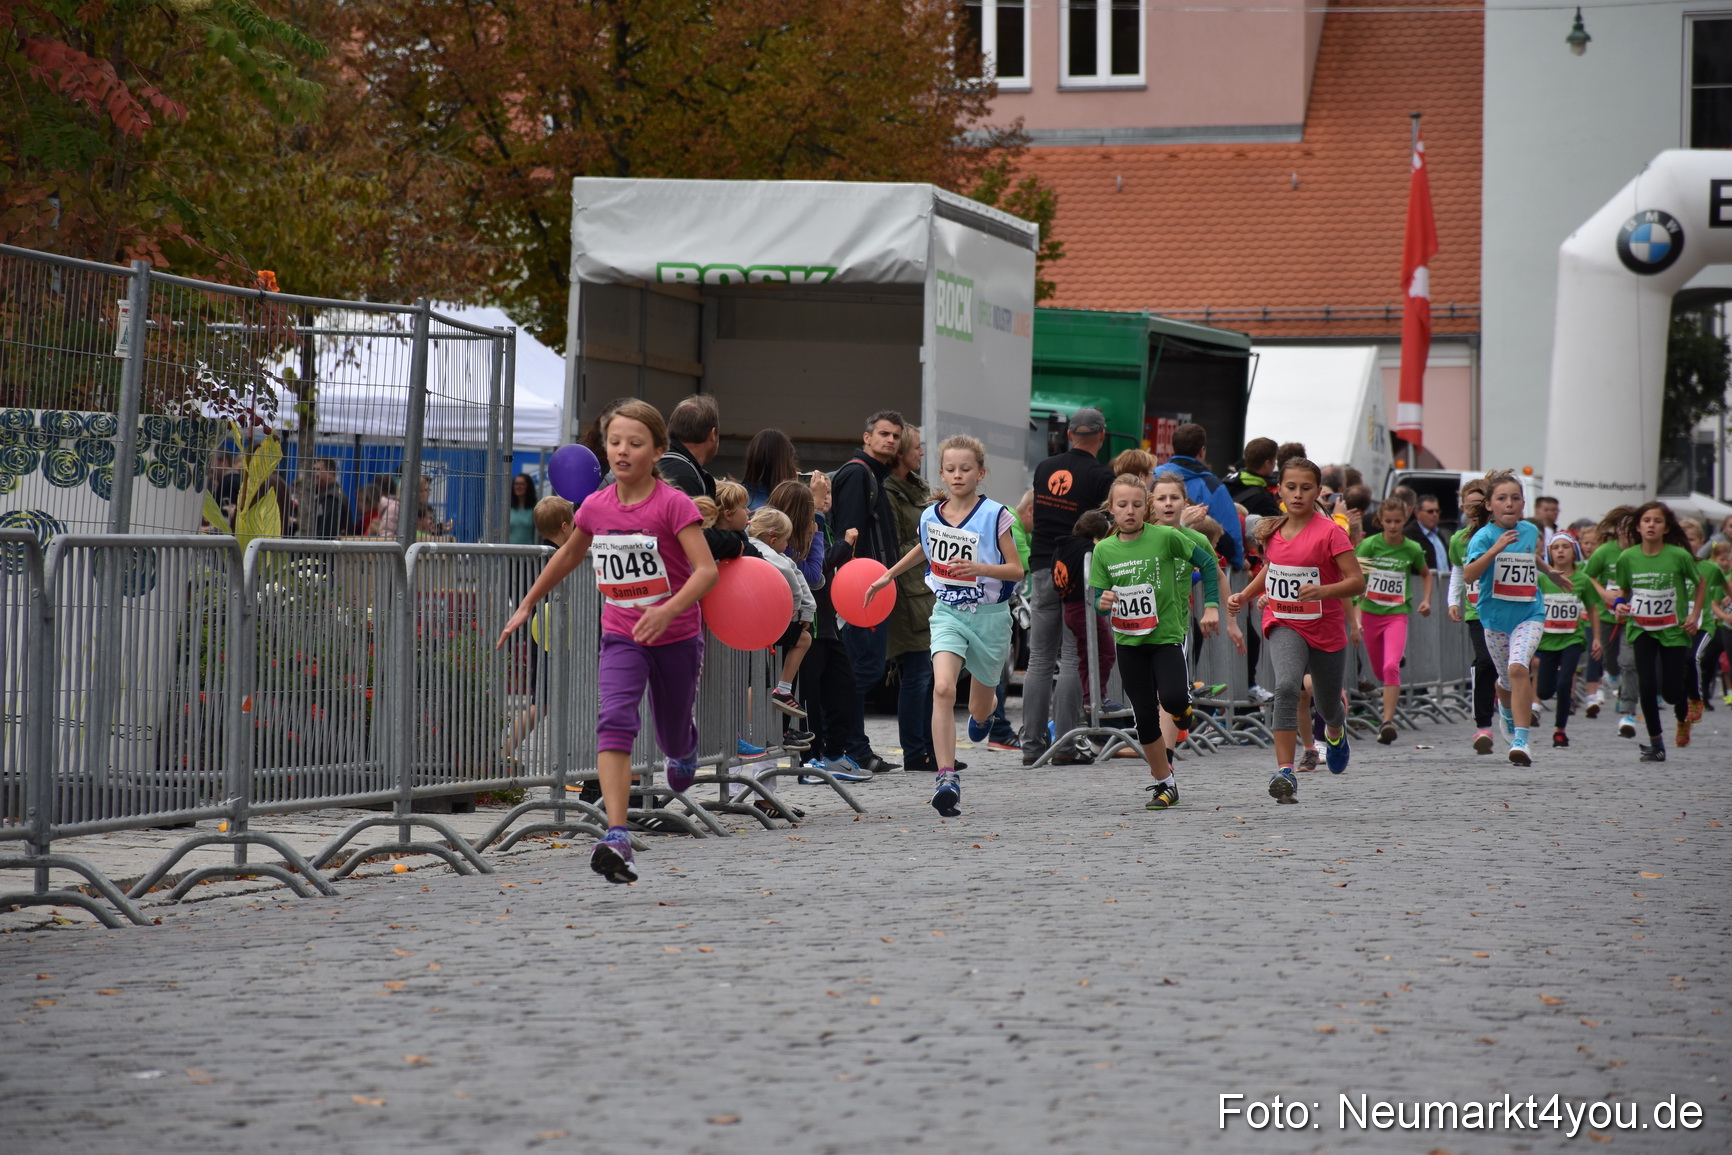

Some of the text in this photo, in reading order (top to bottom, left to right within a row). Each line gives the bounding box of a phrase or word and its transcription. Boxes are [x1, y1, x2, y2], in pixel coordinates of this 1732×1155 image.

[1622, 211, 1680, 234] BMW
[936, 269, 974, 342] BOCK
[942, 532, 968, 542] Neumarkt
[592, 542, 609, 550] PARTL
[930, 537, 972, 561] 7026
[597, 551, 658, 580] 7048
[1107, 559, 1143, 571] Neumarkter
[1501, 565, 1535, 583] 7575
[612, 586, 649, 598] Samina
[1269, 576, 1314, 600] 703
[1372, 577, 1403, 593] 7085
[1276, 603, 1304, 613] Regina
[1544, 604, 1578, 619] 7069
[1635, 599, 1673, 615] 7122
[1123, 621, 1140, 629] Lena
